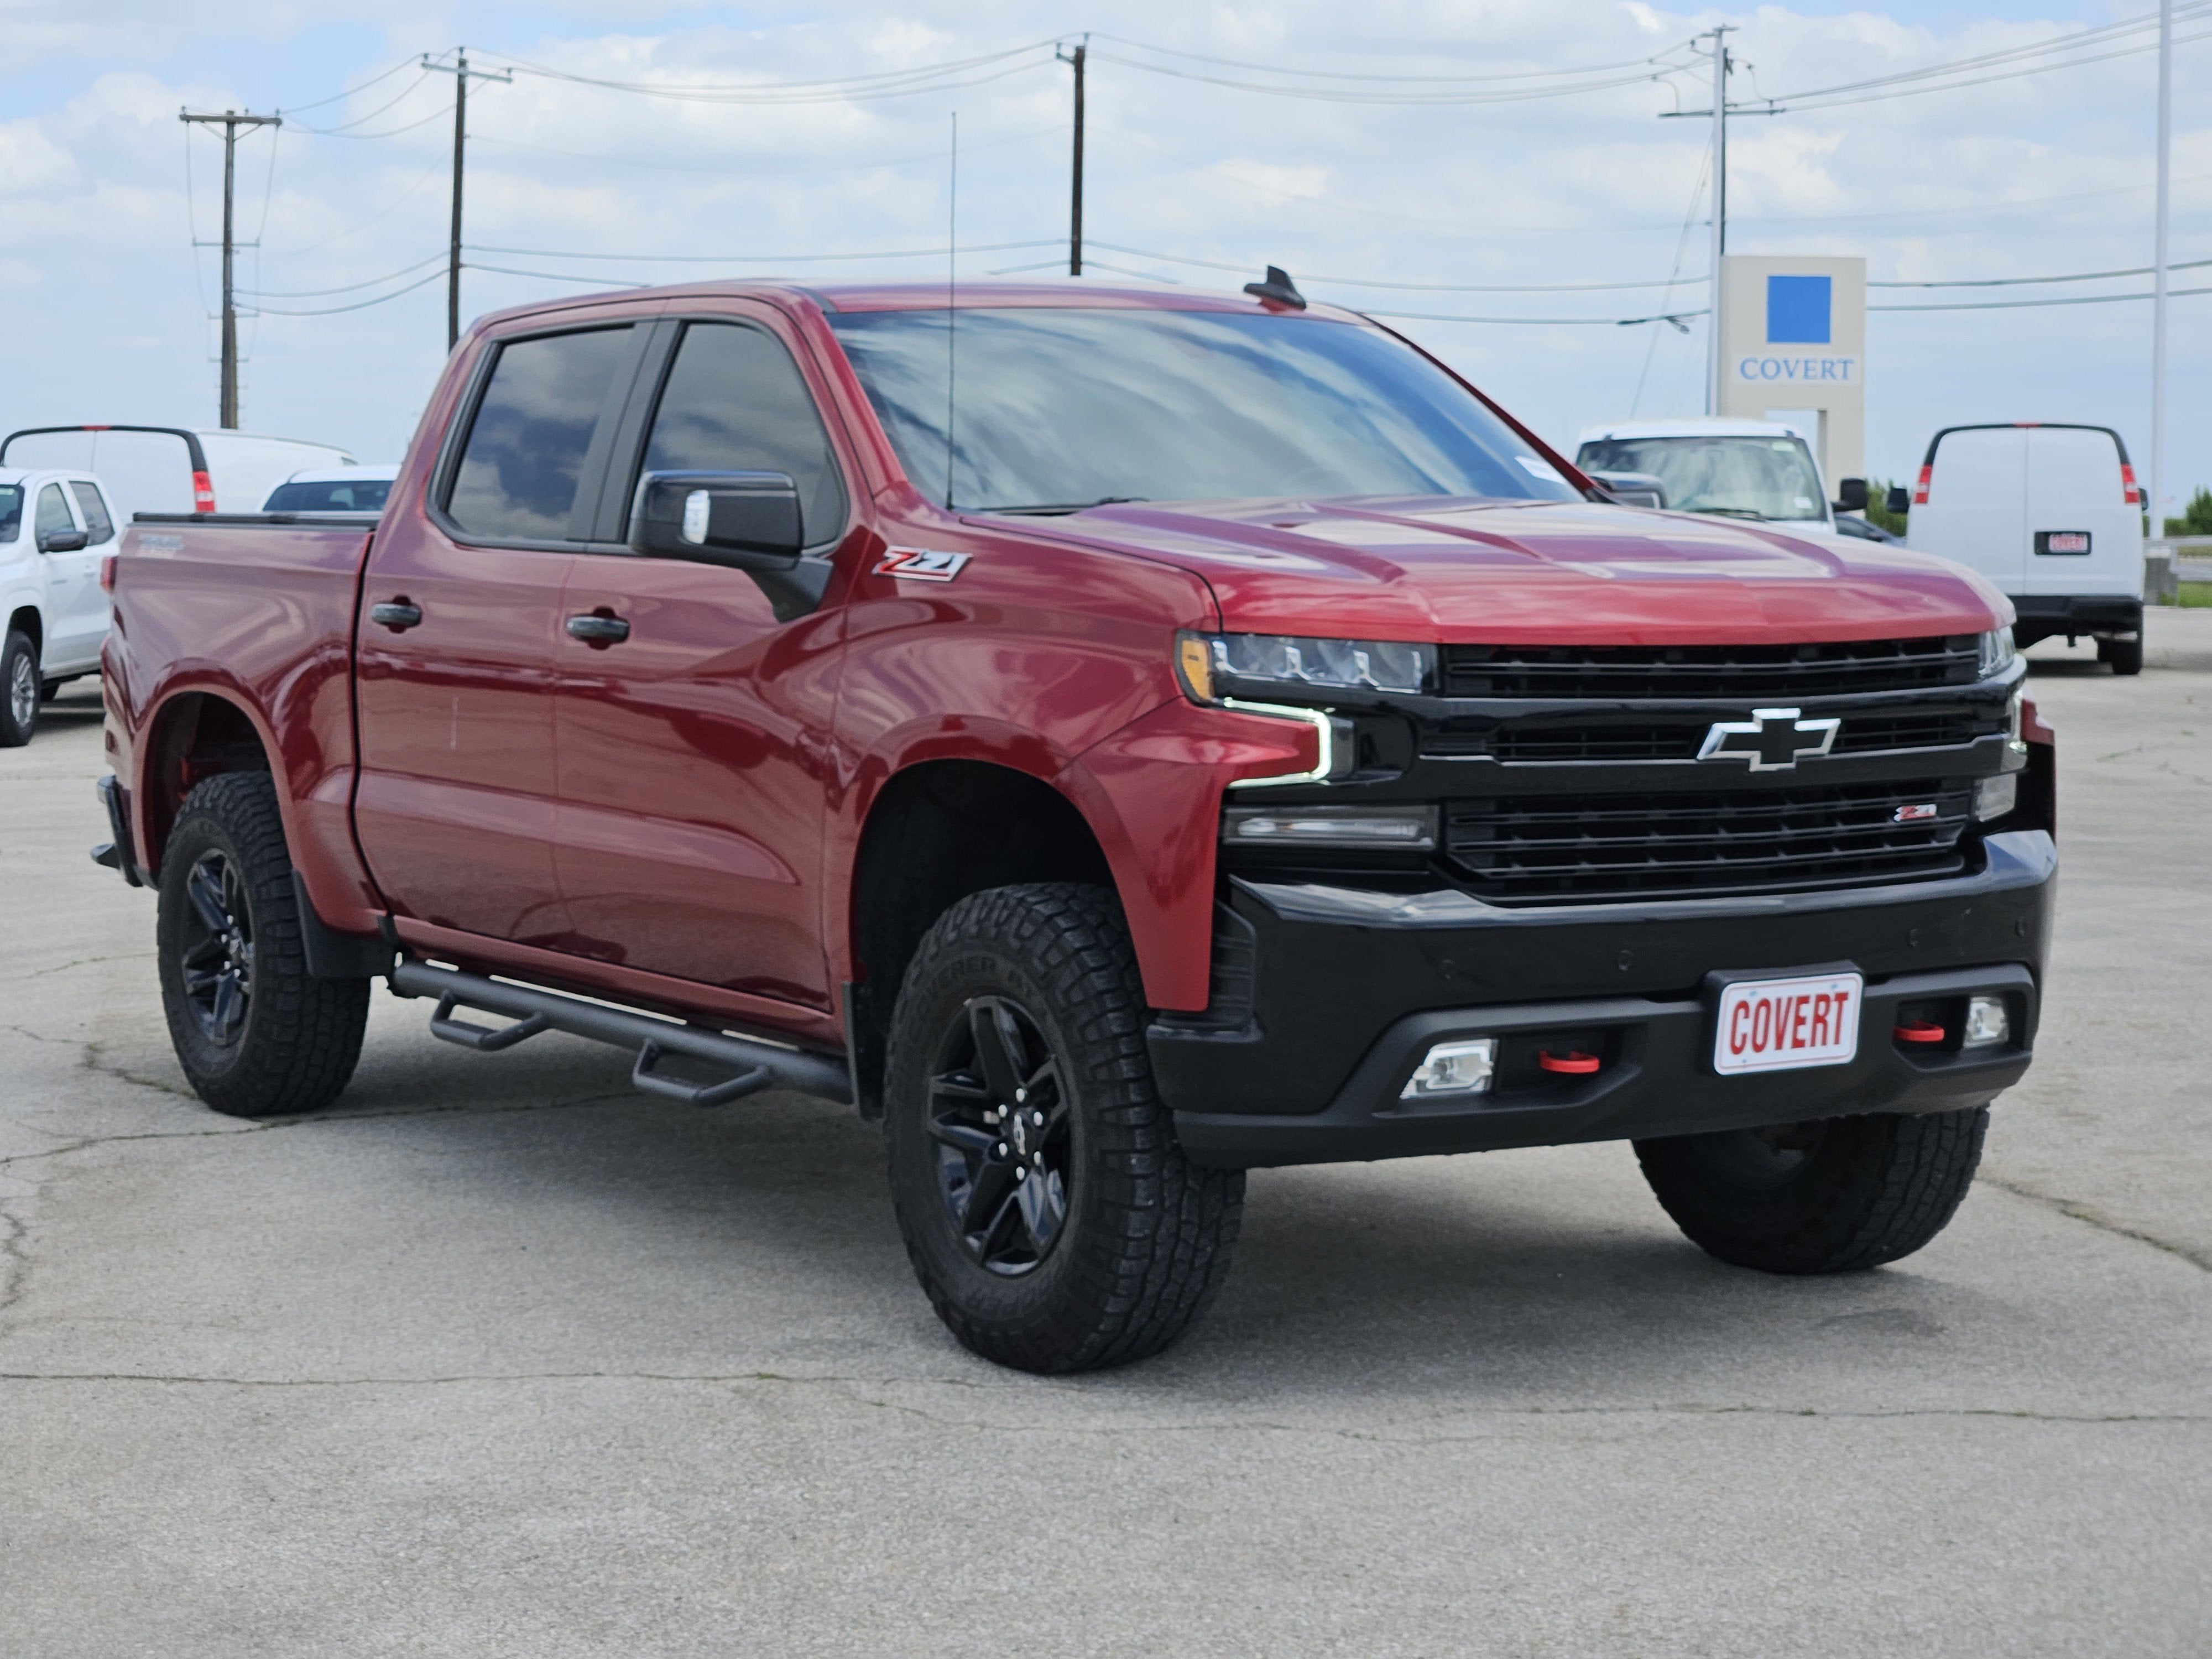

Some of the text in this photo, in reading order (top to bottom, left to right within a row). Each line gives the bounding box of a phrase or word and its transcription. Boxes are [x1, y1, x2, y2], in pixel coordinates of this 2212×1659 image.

[1740, 357, 1854, 380] COVERT
[872, 545, 973, 582] Z71
[1730, 992, 1849, 1055] COVERT
